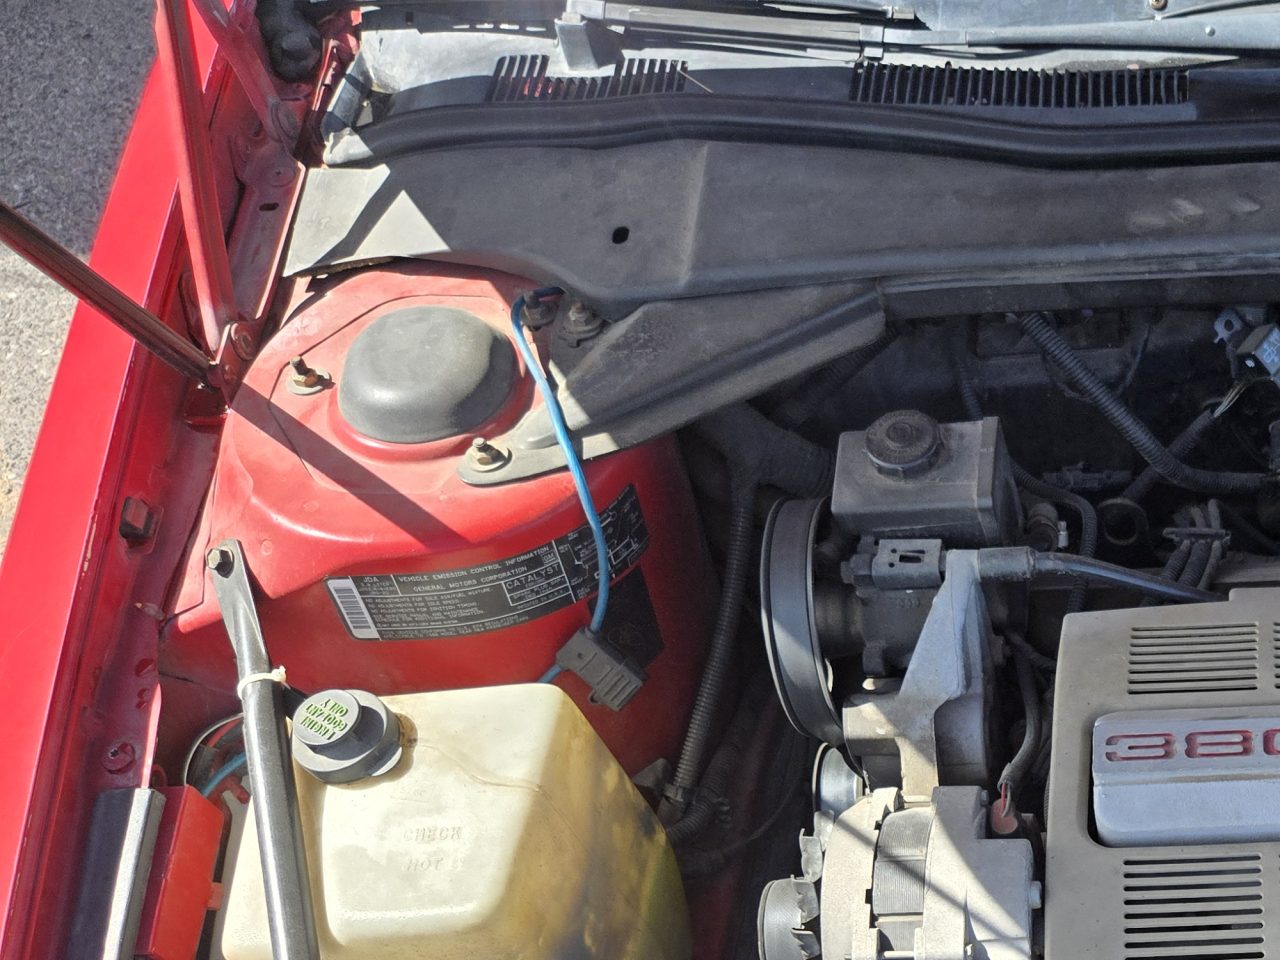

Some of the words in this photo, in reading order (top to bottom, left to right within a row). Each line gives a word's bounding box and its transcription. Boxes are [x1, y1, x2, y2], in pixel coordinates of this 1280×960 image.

[398, 574, 430, 583] VEHICLE
[432, 570, 467, 580] EMISSION
[470, 563, 501, 574] CONTROL
[505, 546, 550, 566] INFORMATION
[506, 564, 560, 590] CATALYST
[413, 584, 446, 592] GENERAL
[448, 580, 477, 588] MOTORS
[480, 566, 528, 583] CORPORATION
[404, 826, 462, 841] CHECK
[407, 857, 444, 872] HOT
